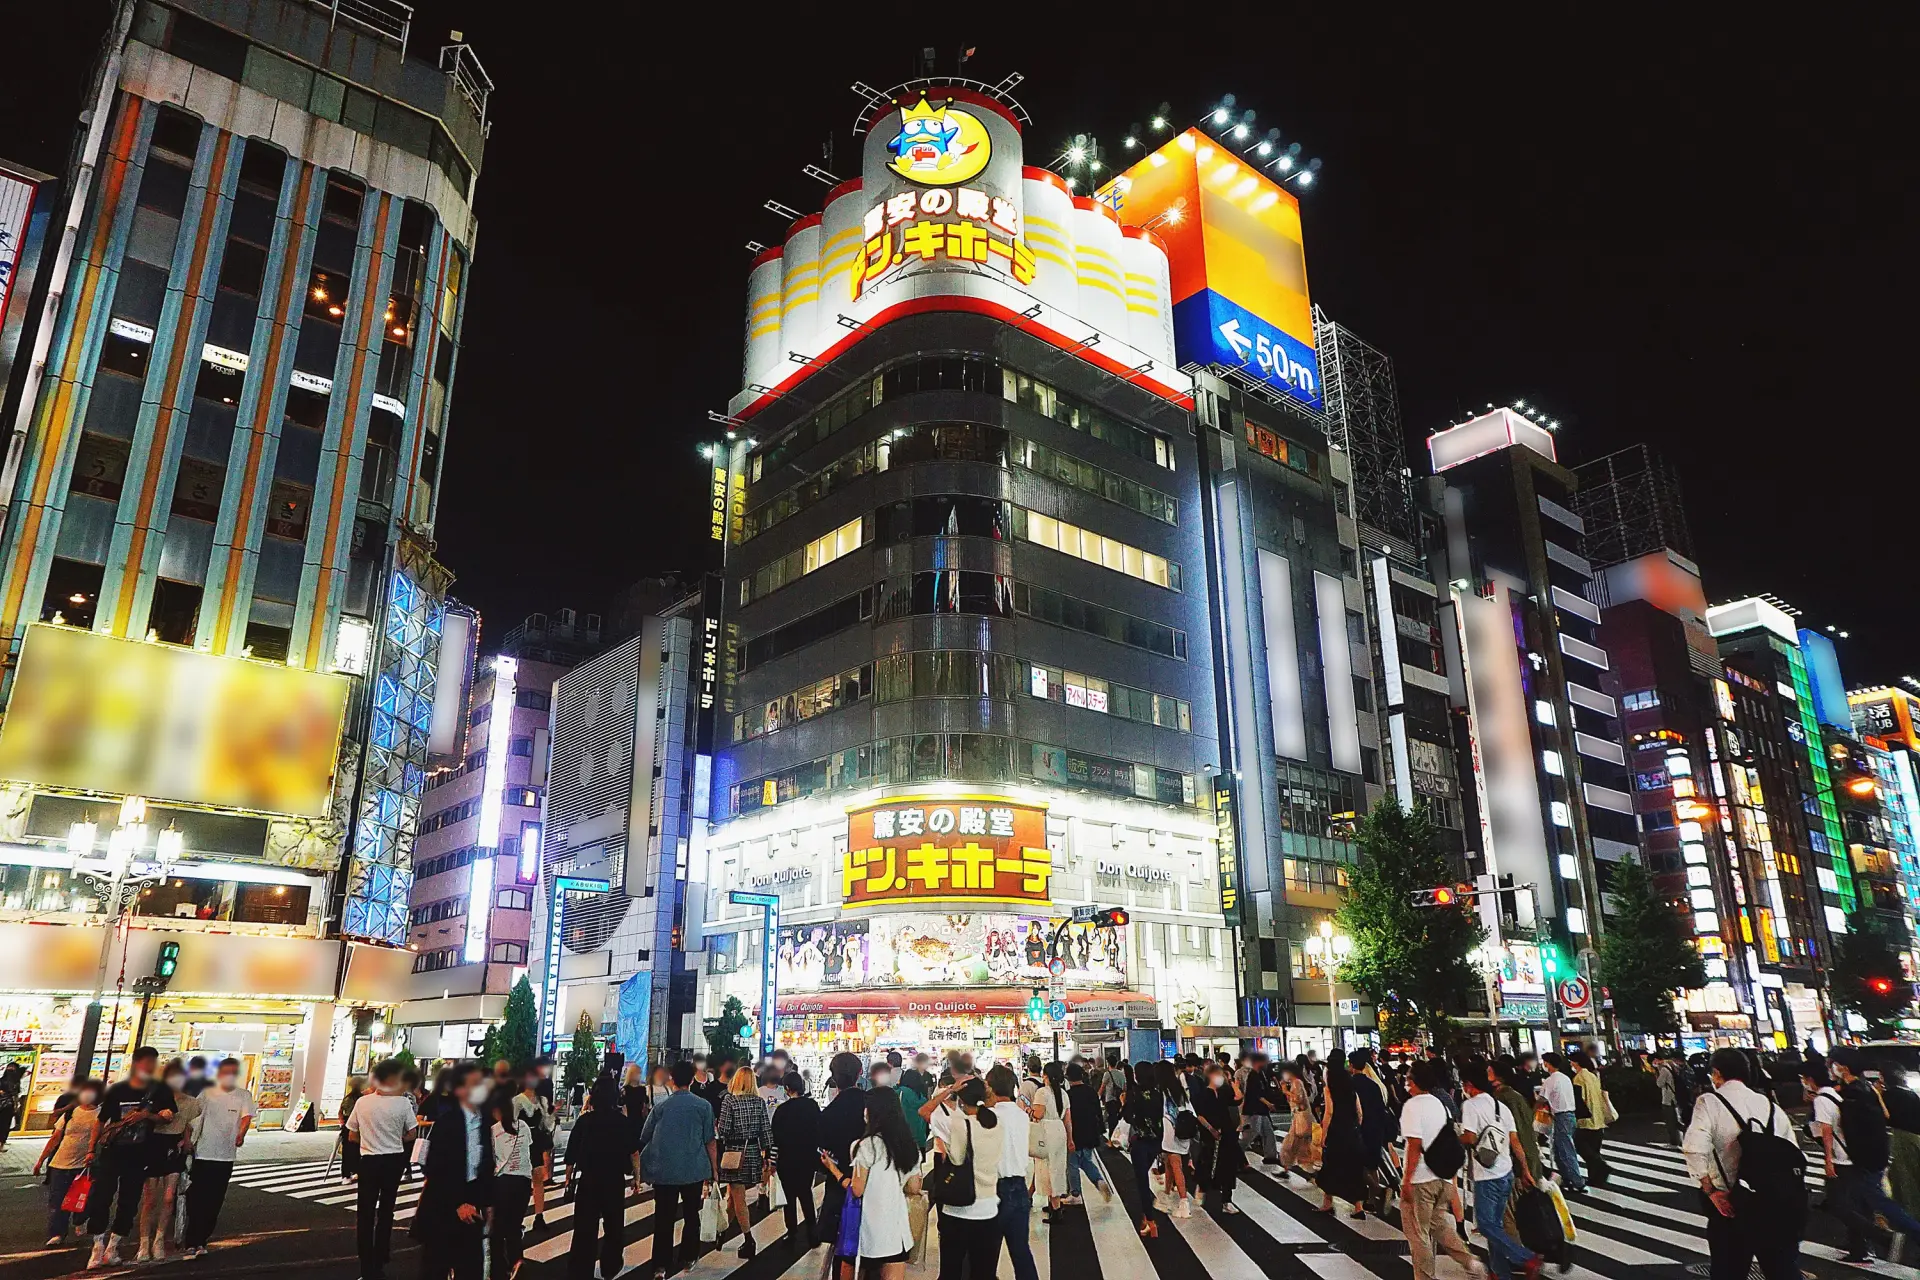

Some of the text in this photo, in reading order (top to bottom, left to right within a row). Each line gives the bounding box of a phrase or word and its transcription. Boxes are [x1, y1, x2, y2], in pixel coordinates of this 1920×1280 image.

[1256, 333, 1314, 392] 50m
[1067, 757, 1088, 776] 販売
[872, 807, 1015, 840] 驚安の殿堂
[750, 865, 811, 888] Don Quijote
[1097, 859, 1172, 883] Don Quijote
[545, 901, 563, 1028] GODZILLA ROAD
[786, 1002, 824, 1013] Don Quijote
[909, 1001, 977, 1012] Don Quijote
